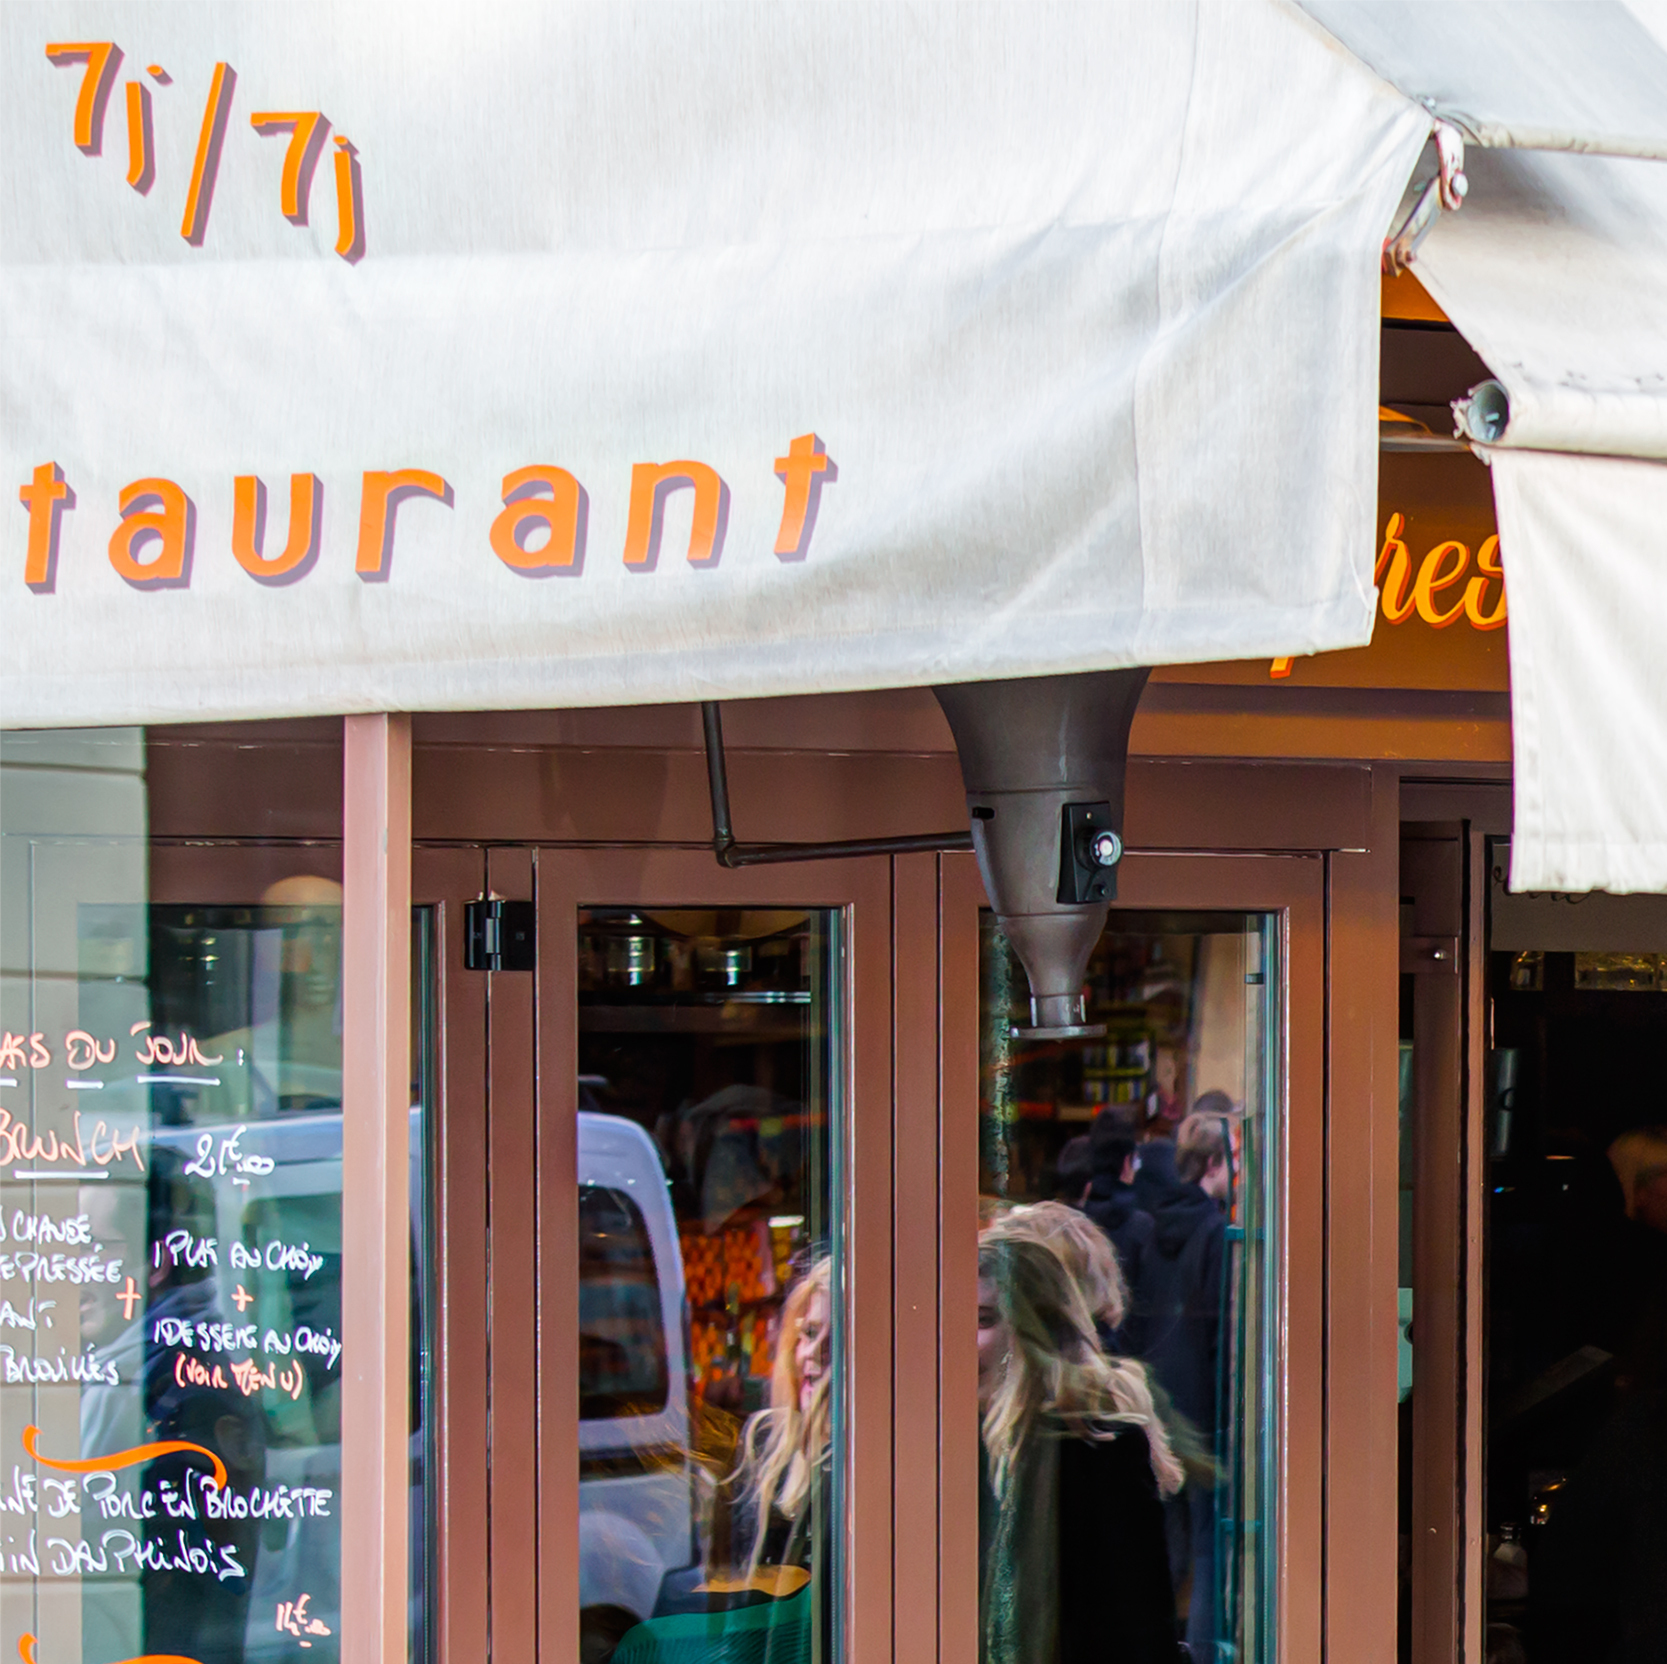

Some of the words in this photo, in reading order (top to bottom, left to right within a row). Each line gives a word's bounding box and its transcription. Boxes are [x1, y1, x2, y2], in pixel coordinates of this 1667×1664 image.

[19, 432, 838, 595] taurant
[65, 1029, 116, 1071] DU
[165, 1229, 218, 1268] PLAT
[229, 1241, 263, 1268] AU
[44, 1478, 80, 1518] DE
